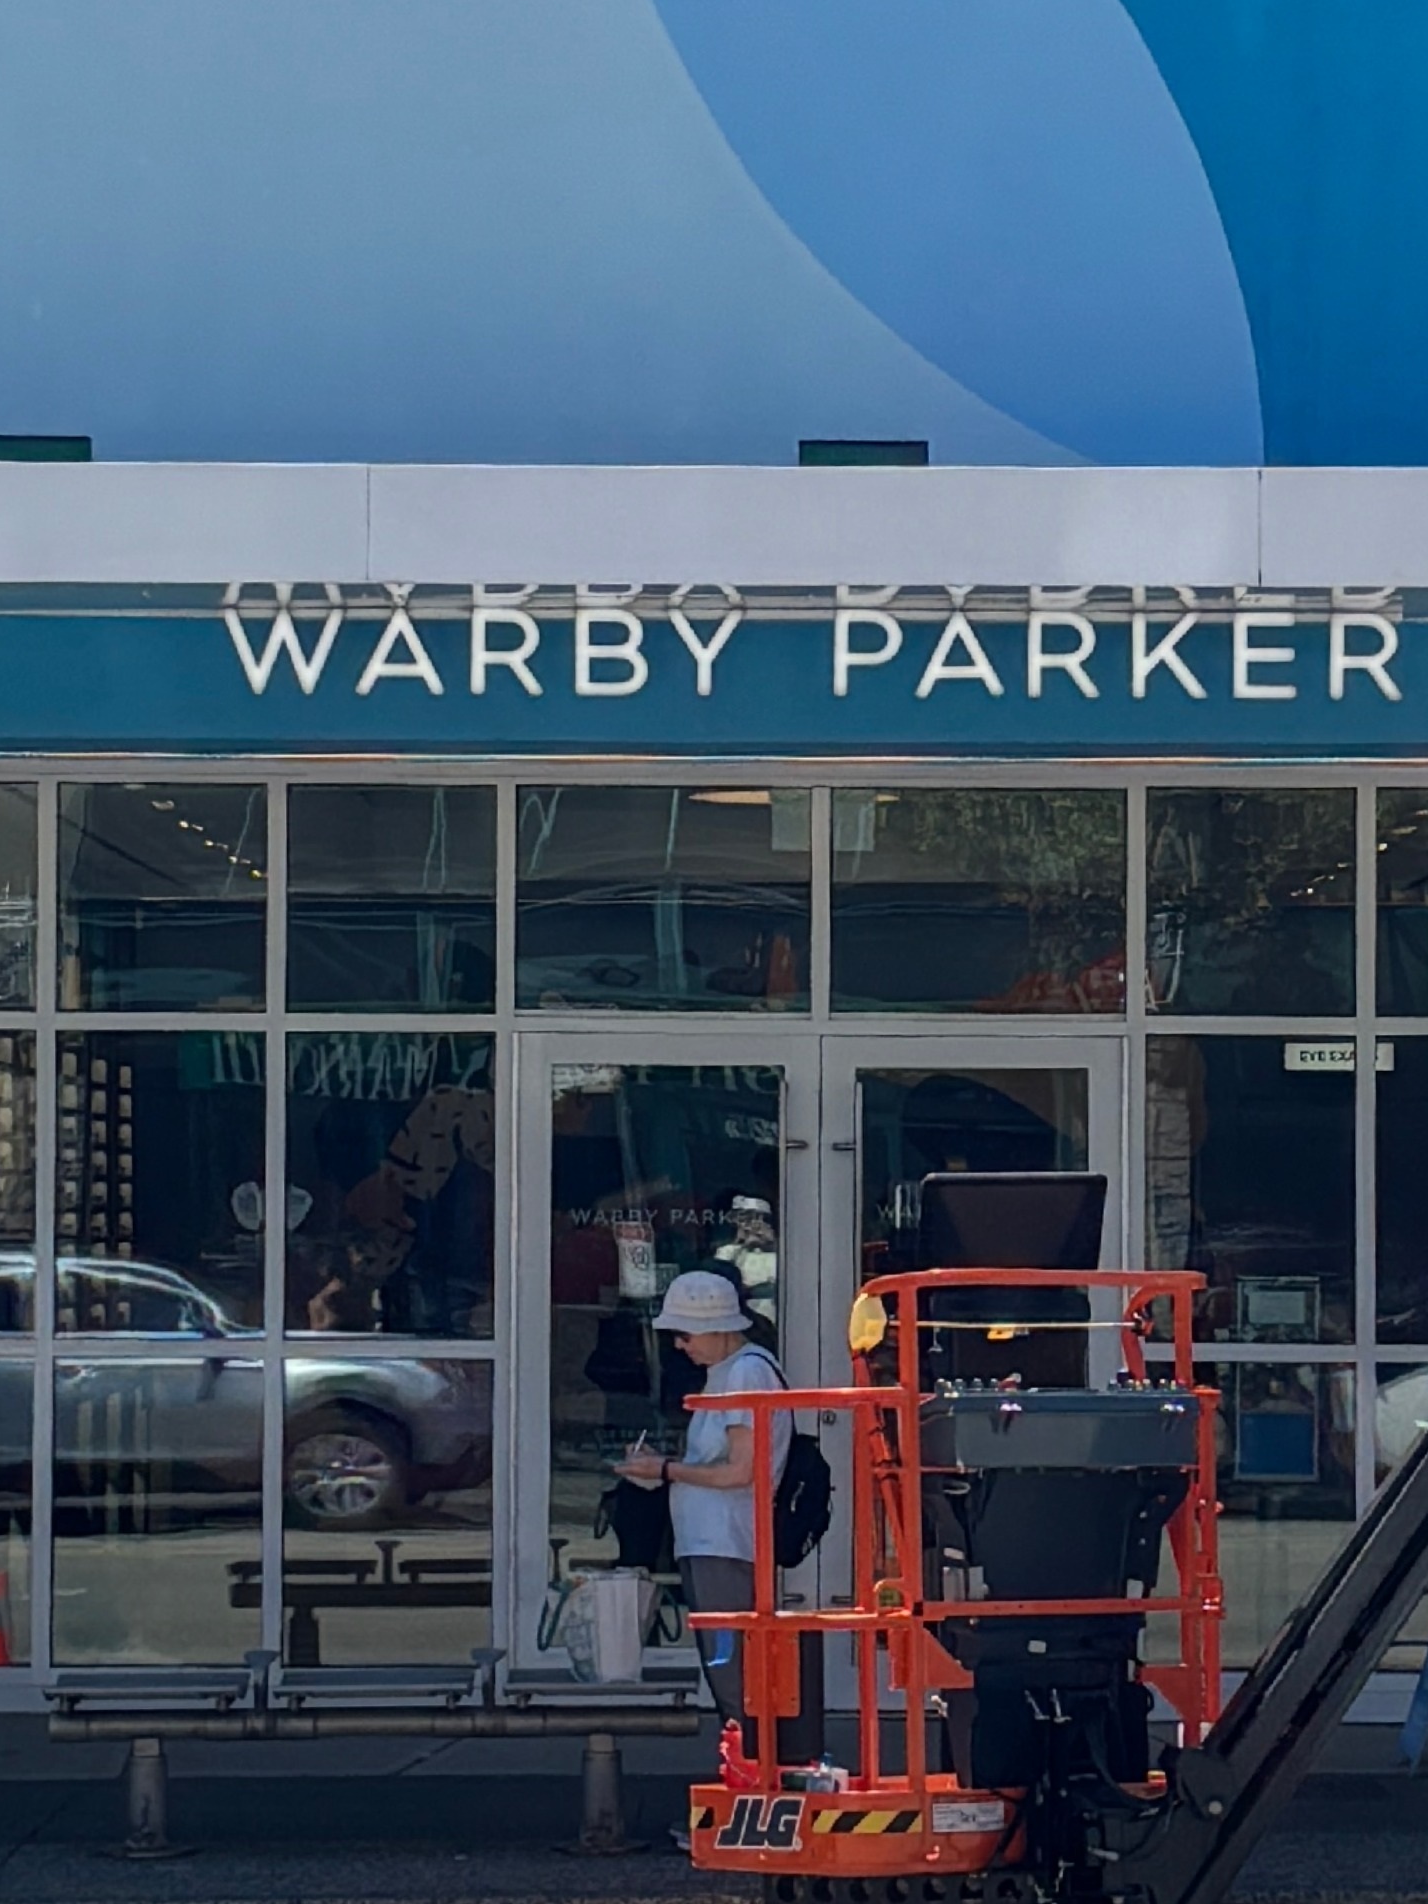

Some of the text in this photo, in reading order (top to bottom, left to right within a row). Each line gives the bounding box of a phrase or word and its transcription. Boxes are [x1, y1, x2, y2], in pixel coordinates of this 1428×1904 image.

[223, 607, 1403, 700] WARBY PARKER
[1300, 1050, 1326, 1062] EYE
[570, 1208, 658, 1226] WARBY
[715, 1795, 805, 1850] JLG
